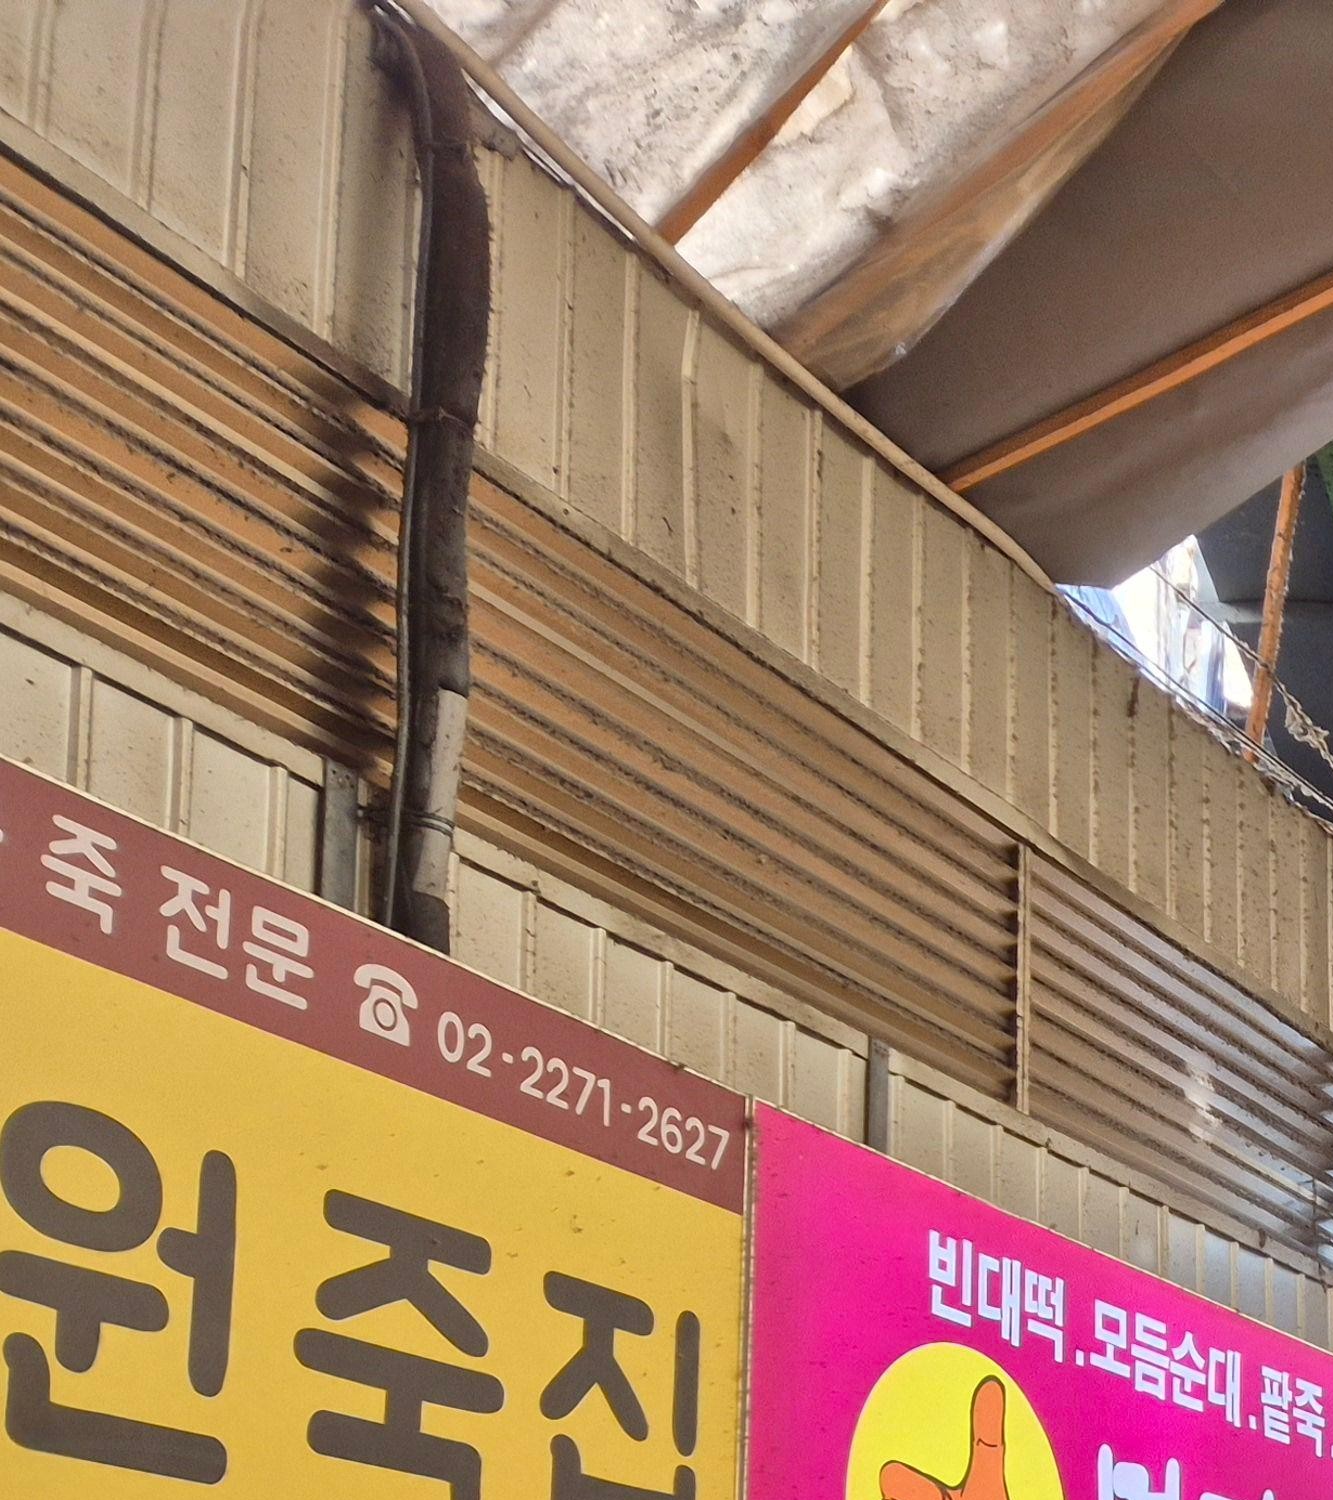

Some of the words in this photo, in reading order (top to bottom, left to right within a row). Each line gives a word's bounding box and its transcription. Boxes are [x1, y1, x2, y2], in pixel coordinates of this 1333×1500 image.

[40, 813, 122, 935] 죽
[159, 865, 314, 1010] 전문
[437, 1011, 730, 1170] 02-2271-2627
